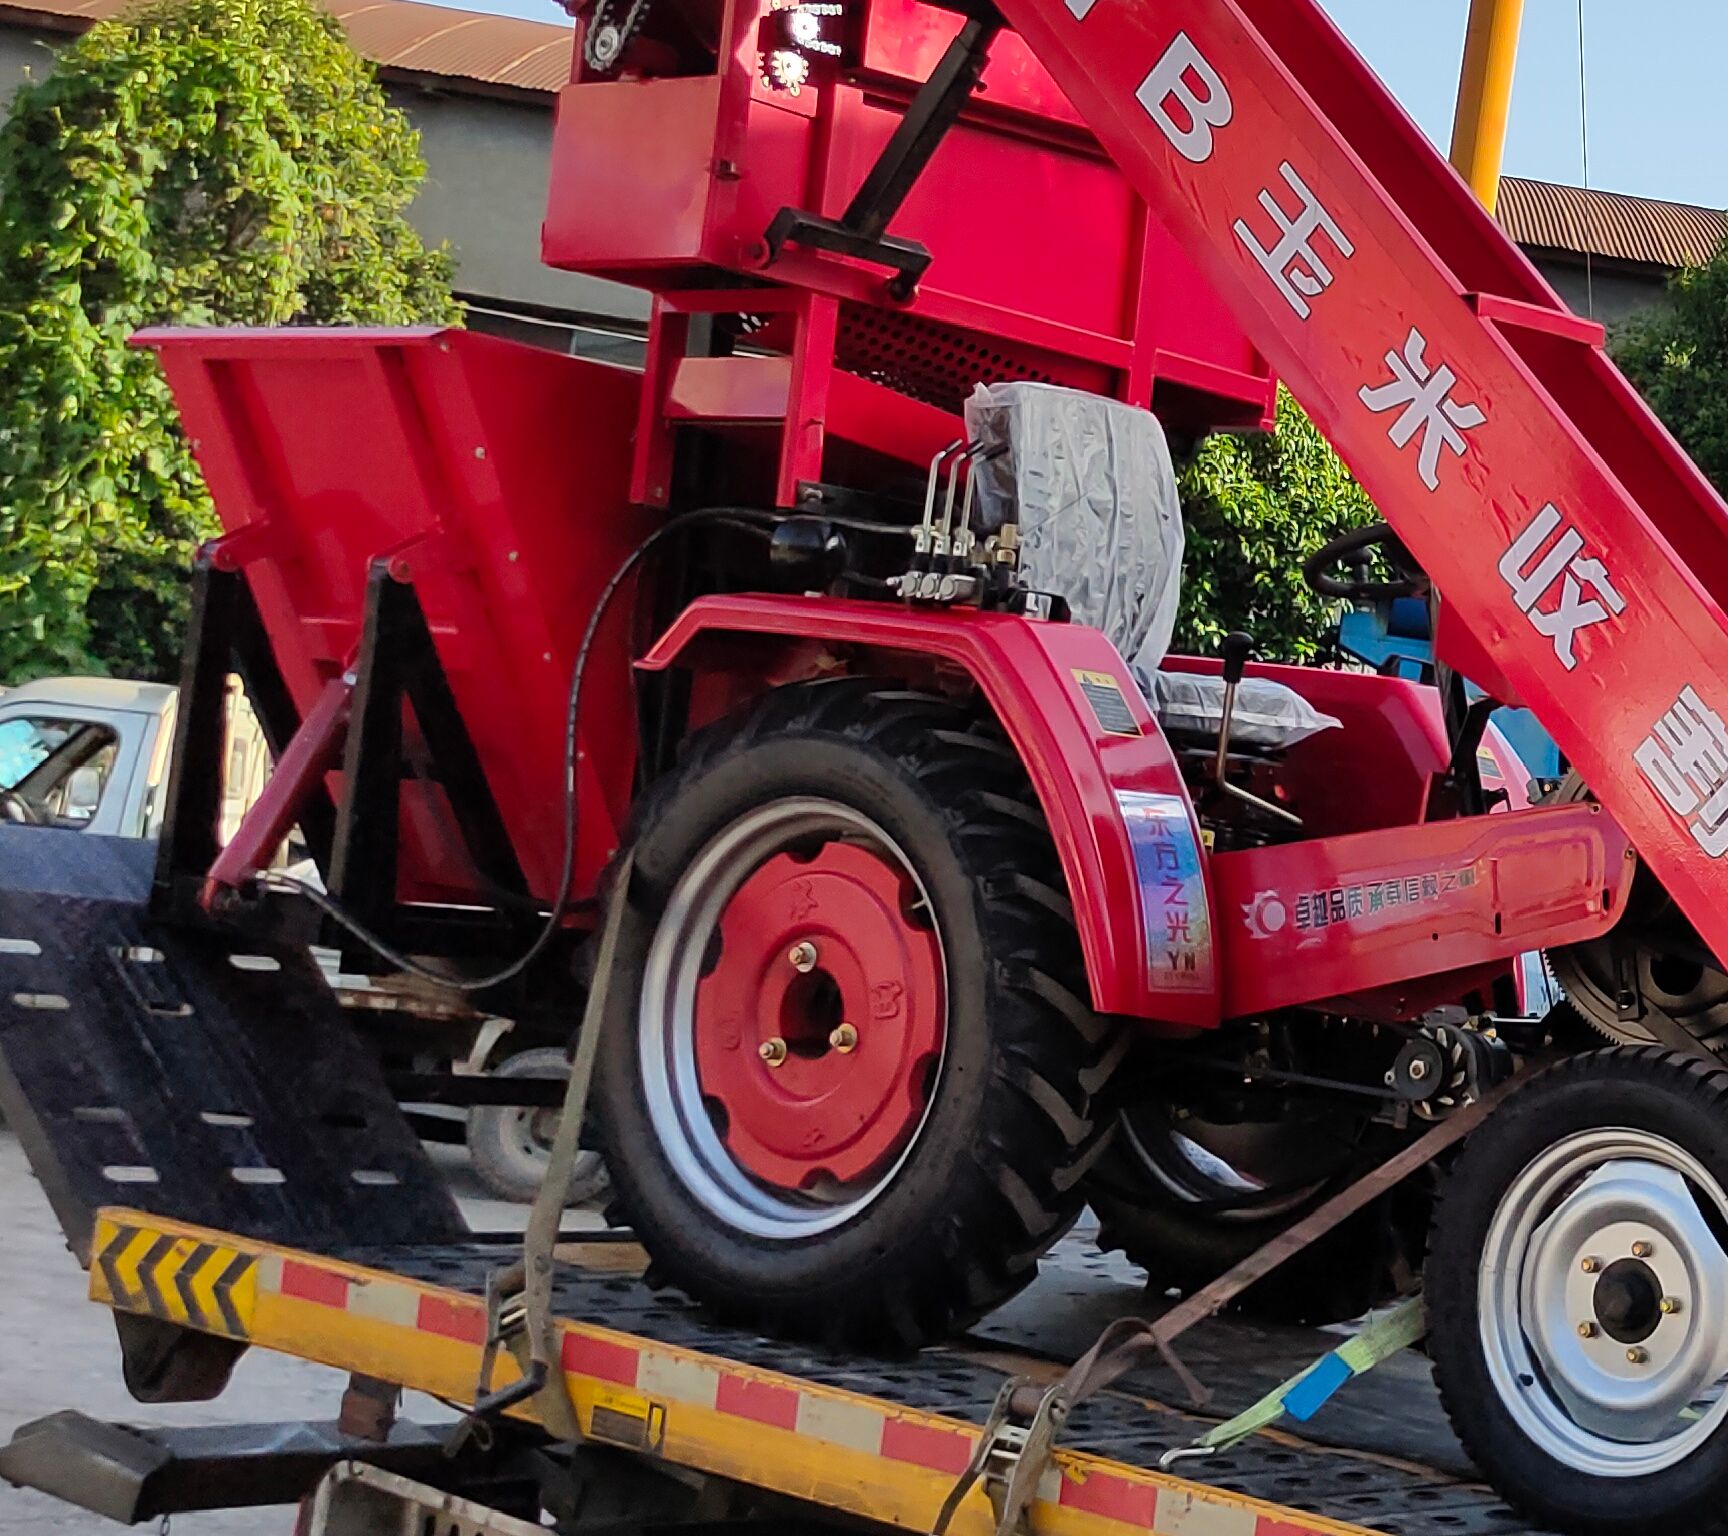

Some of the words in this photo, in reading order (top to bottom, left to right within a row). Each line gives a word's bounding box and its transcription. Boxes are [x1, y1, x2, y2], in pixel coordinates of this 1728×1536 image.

[1142, 806, 1194, 944] 东方之光
[1166, 950, 1196, 972] YN
